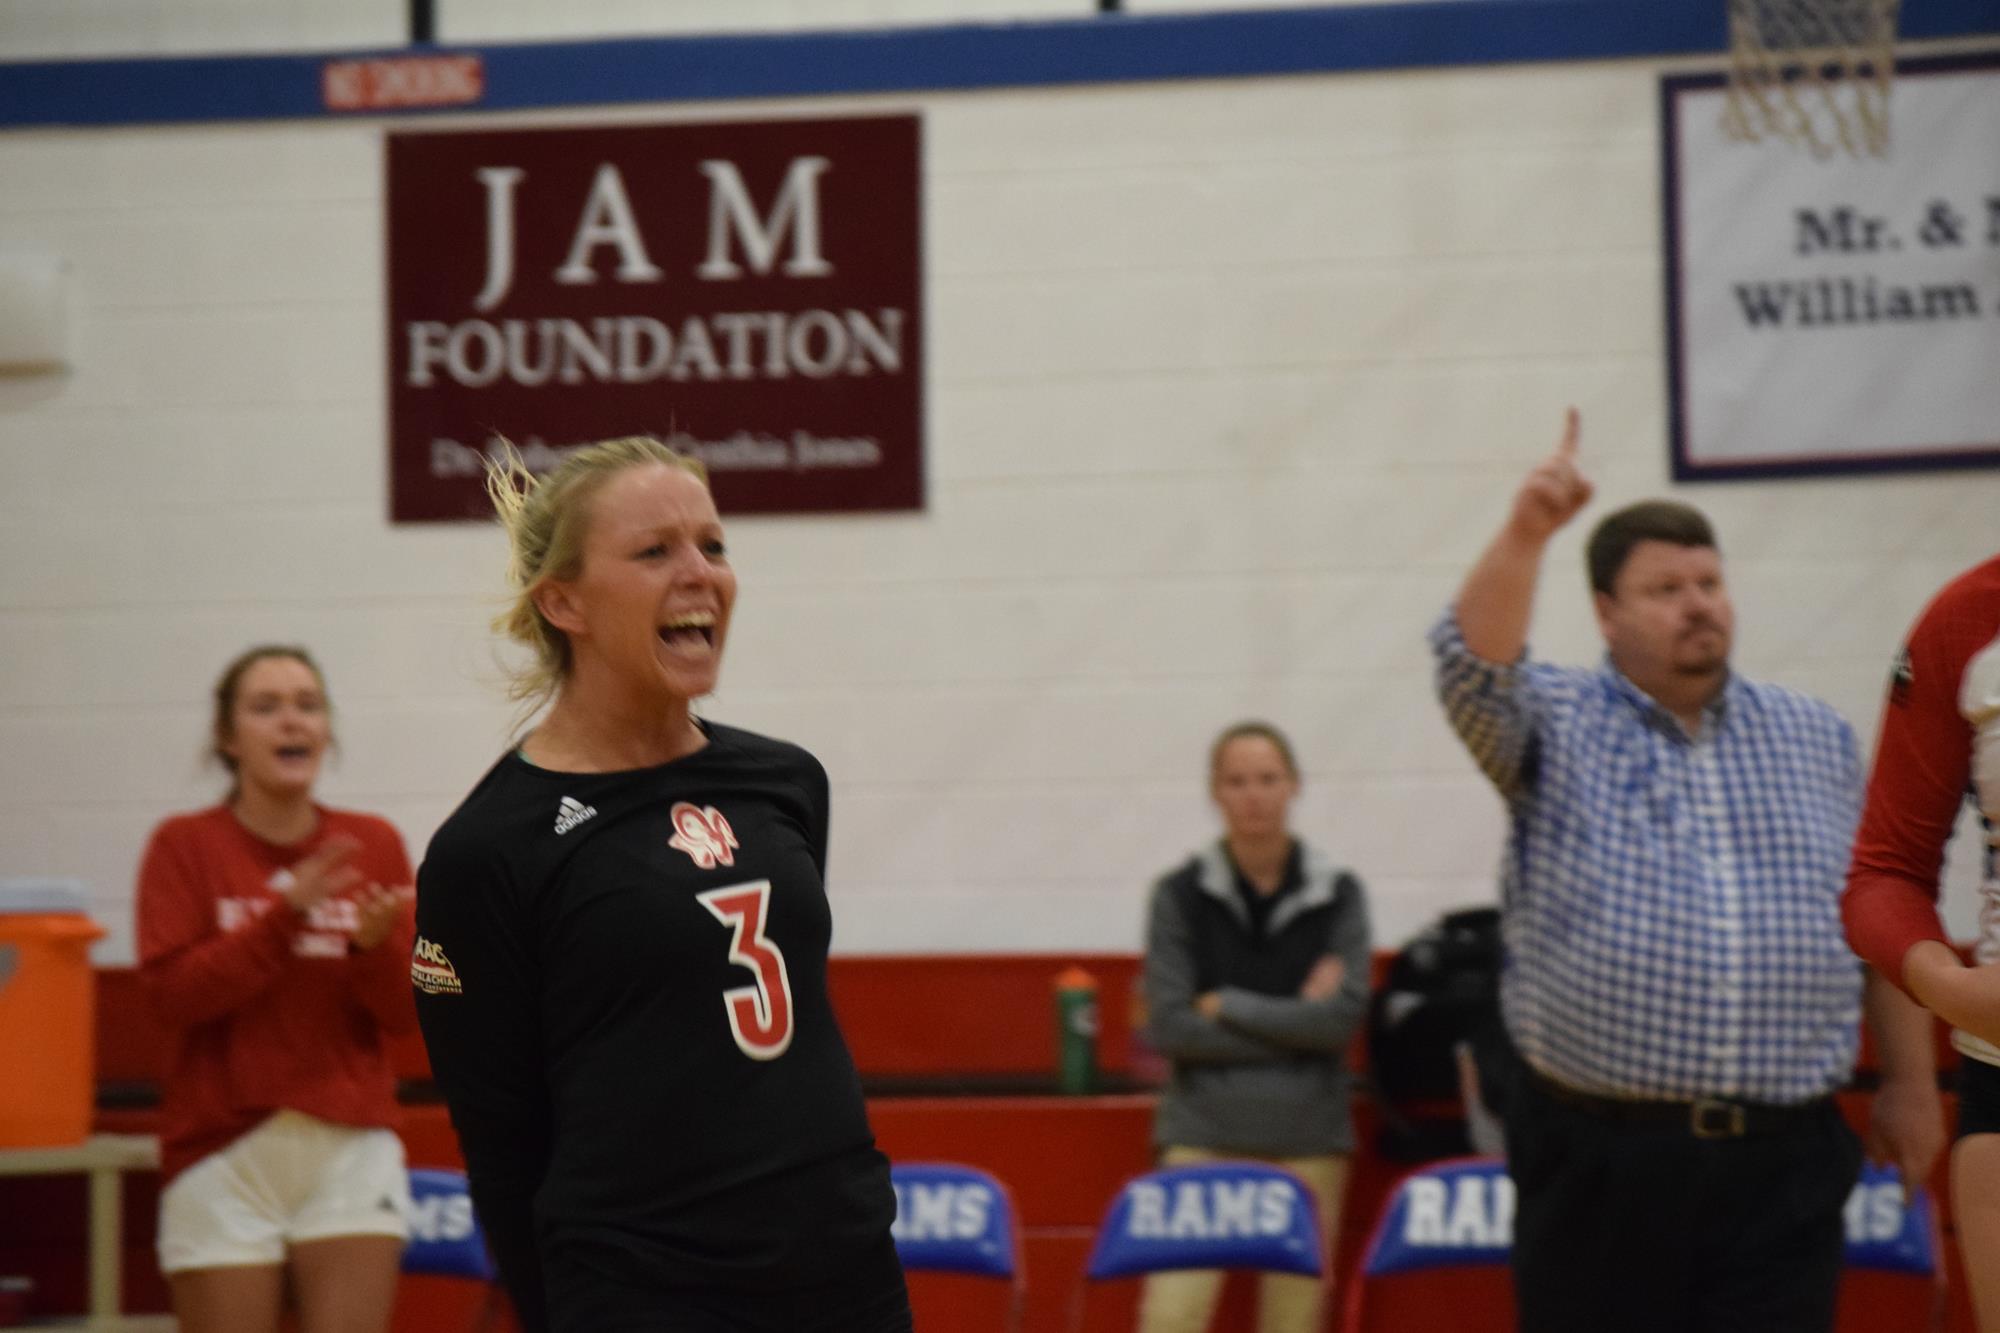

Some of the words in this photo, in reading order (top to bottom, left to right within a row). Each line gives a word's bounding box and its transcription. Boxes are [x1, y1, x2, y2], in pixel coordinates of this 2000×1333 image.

[1795, 203, 1903, 257] Mr.
[1917, 199, 1966, 250] &
[1731, 275, 1983, 331] William
[405, 307, 906, 388] FOUNDATION
[554, 805, 598, 835] adidas
[696, 878, 794, 1061] 3
[891, 1181, 992, 1240] MS
[1126, 1179, 1297, 1239] RAMS
